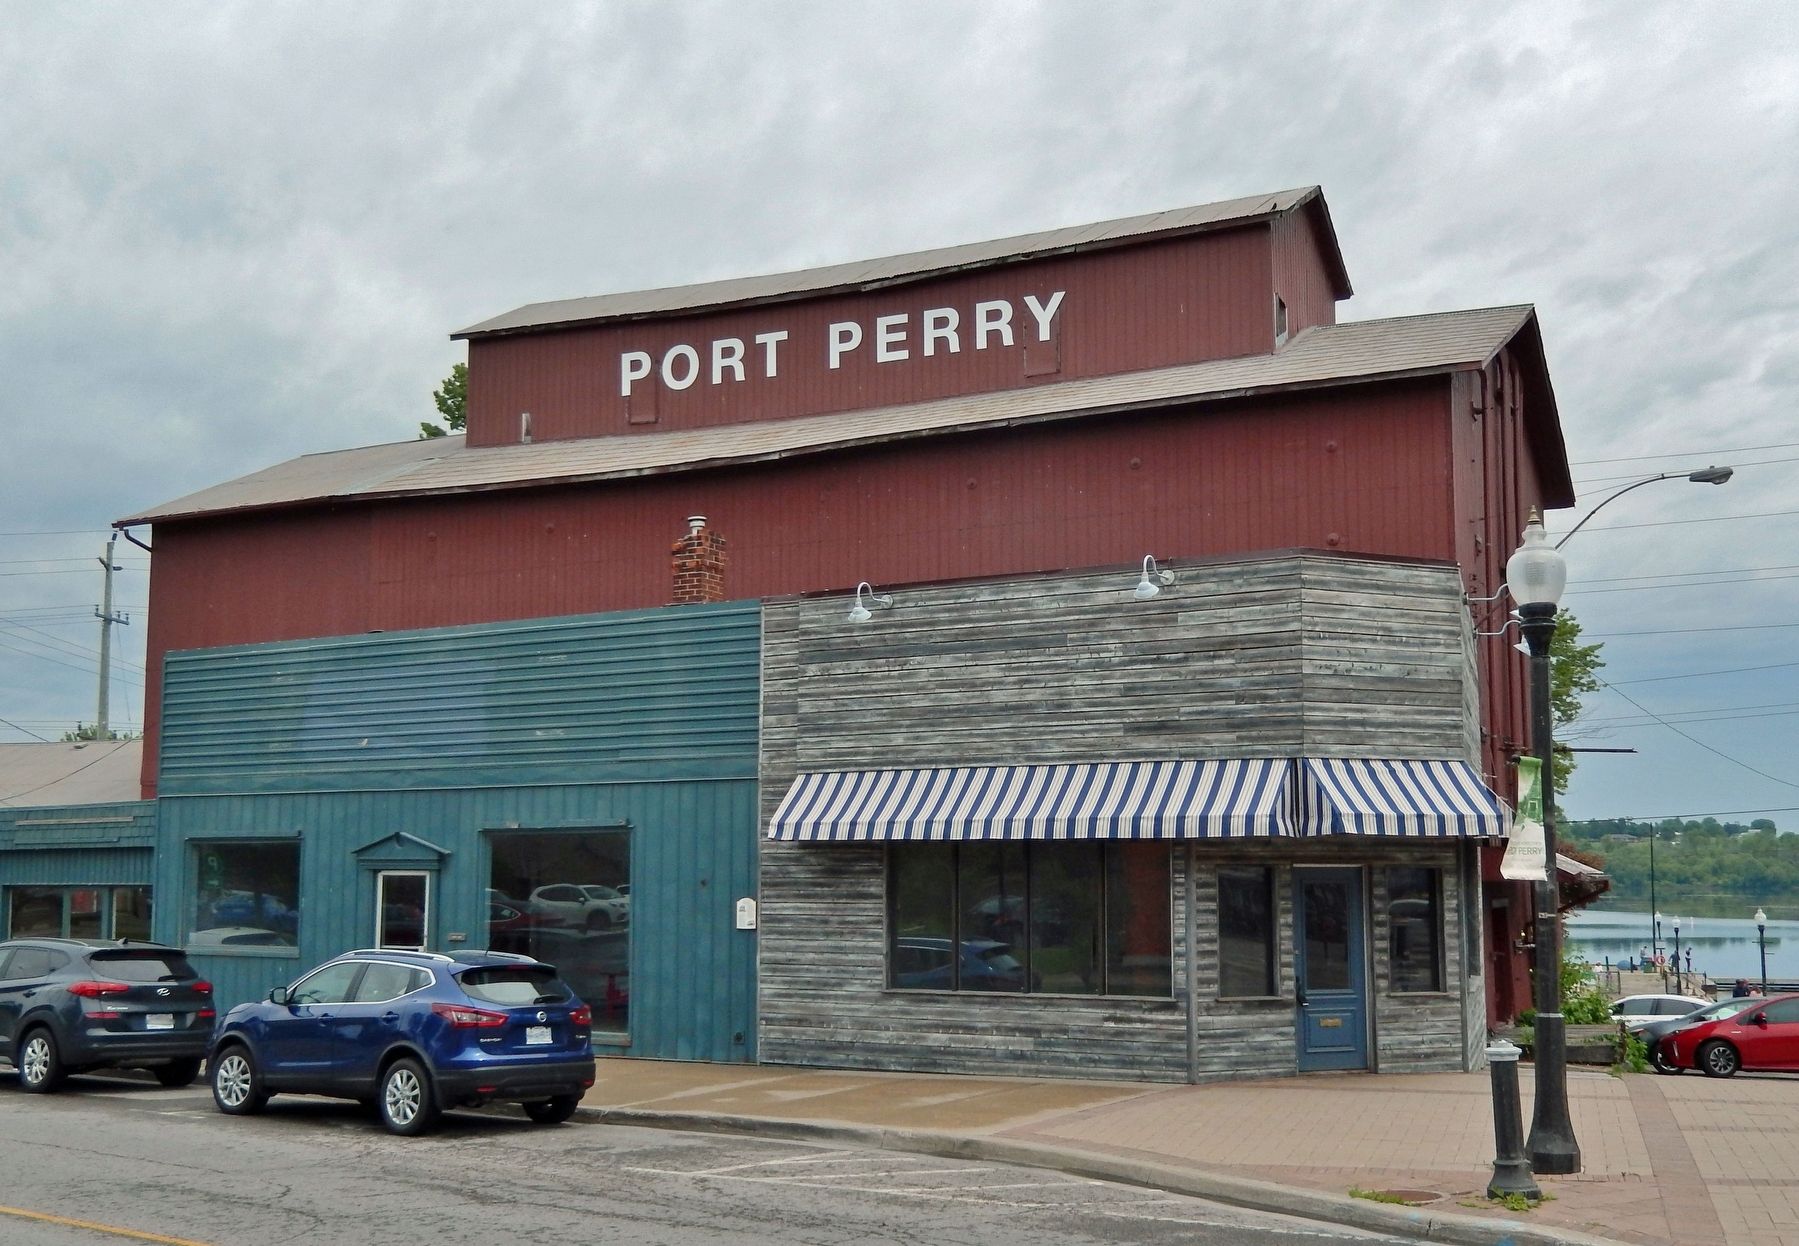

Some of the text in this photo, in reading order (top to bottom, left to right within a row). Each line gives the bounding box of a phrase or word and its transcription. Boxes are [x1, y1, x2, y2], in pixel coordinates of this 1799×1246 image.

[620, 291, 1067, 397] PORT PERRY
[1518, 846, 1543, 856] PERRY
